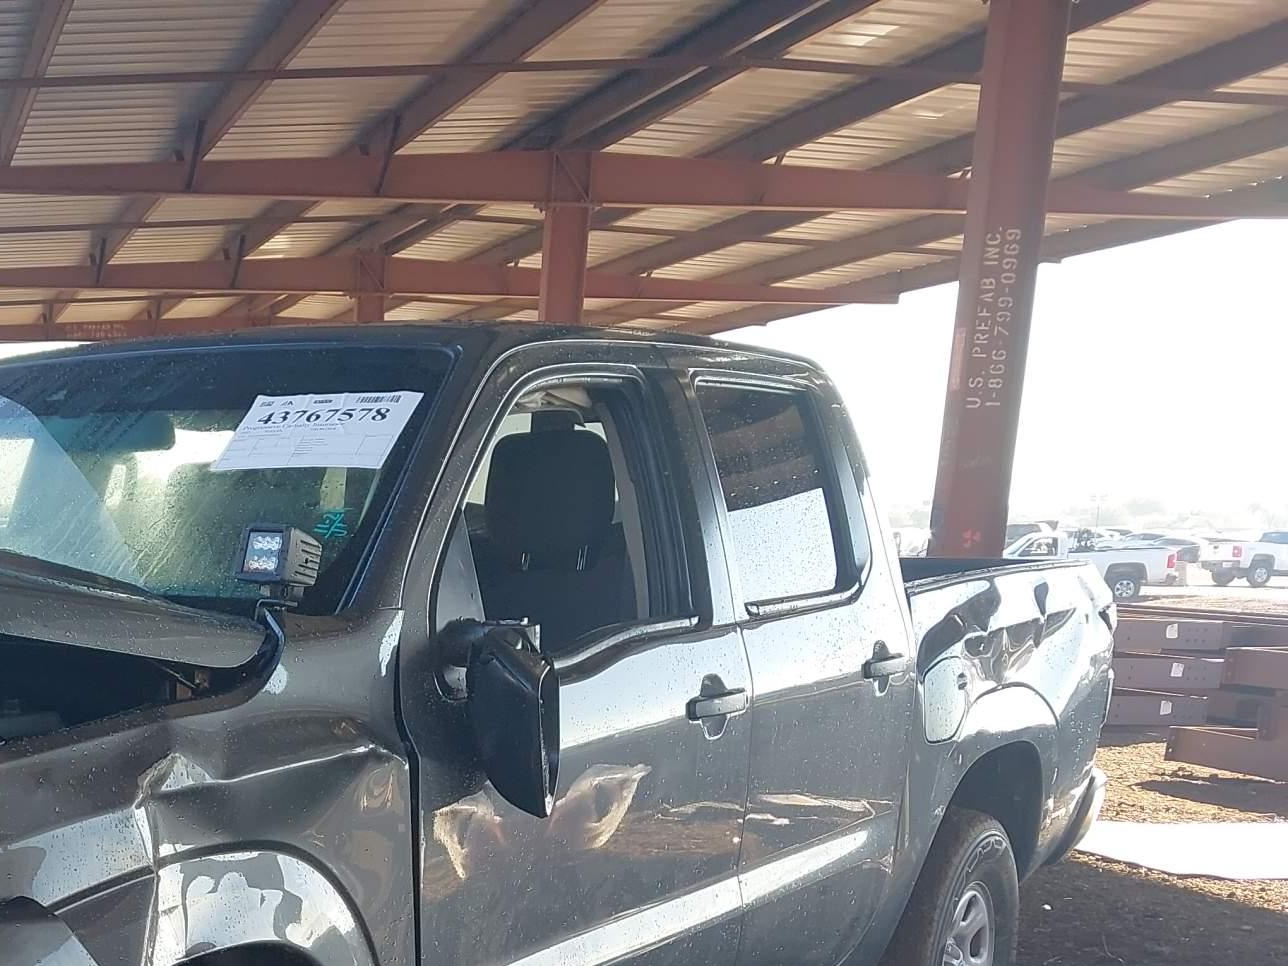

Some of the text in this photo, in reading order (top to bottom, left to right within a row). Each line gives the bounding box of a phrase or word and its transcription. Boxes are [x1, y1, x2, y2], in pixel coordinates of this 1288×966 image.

[966, 226, 1003, 409] U.S. PREFAB INC.
[985, 228, 1021, 406] 1-866-799-0969
[257, 407, 391, 425] 43767578
